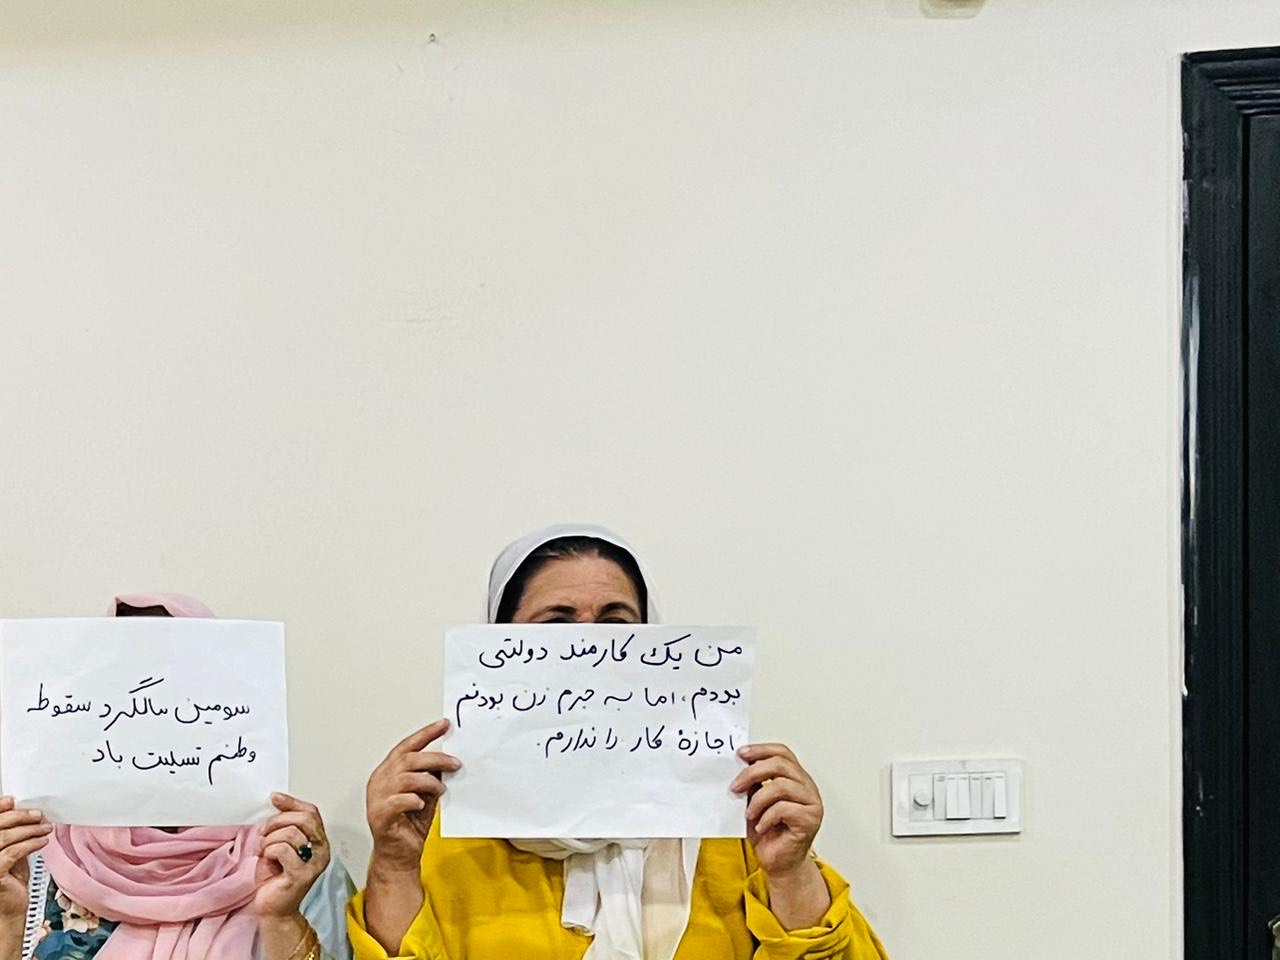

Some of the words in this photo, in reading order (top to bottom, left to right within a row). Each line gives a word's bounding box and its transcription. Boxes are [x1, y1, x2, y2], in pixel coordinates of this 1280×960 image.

[479, 638, 548, 669] دولتی
[560, 634, 635, 668] کارمند
[640, 634, 691, 670] یک
[695, 645, 742, 667] من
[27, 683, 91, 717] سقوط
[99, 677, 168, 731] سالگرد
[456, 683, 503, 728] بودنم
[512, 688, 549, 711] زن
[557, 689, 595, 715] جرم
[604, 691, 633, 711] به
[645, 687, 675, 706] اما
[175, 698, 250, 724] سومین
[605, 728, 618, 750] را
[630, 725, 665, 752] کار
[92, 740, 123, 769] باد
[132, 747, 202, 774] تسلیت
[208, 736, 256, 786] وطنم
